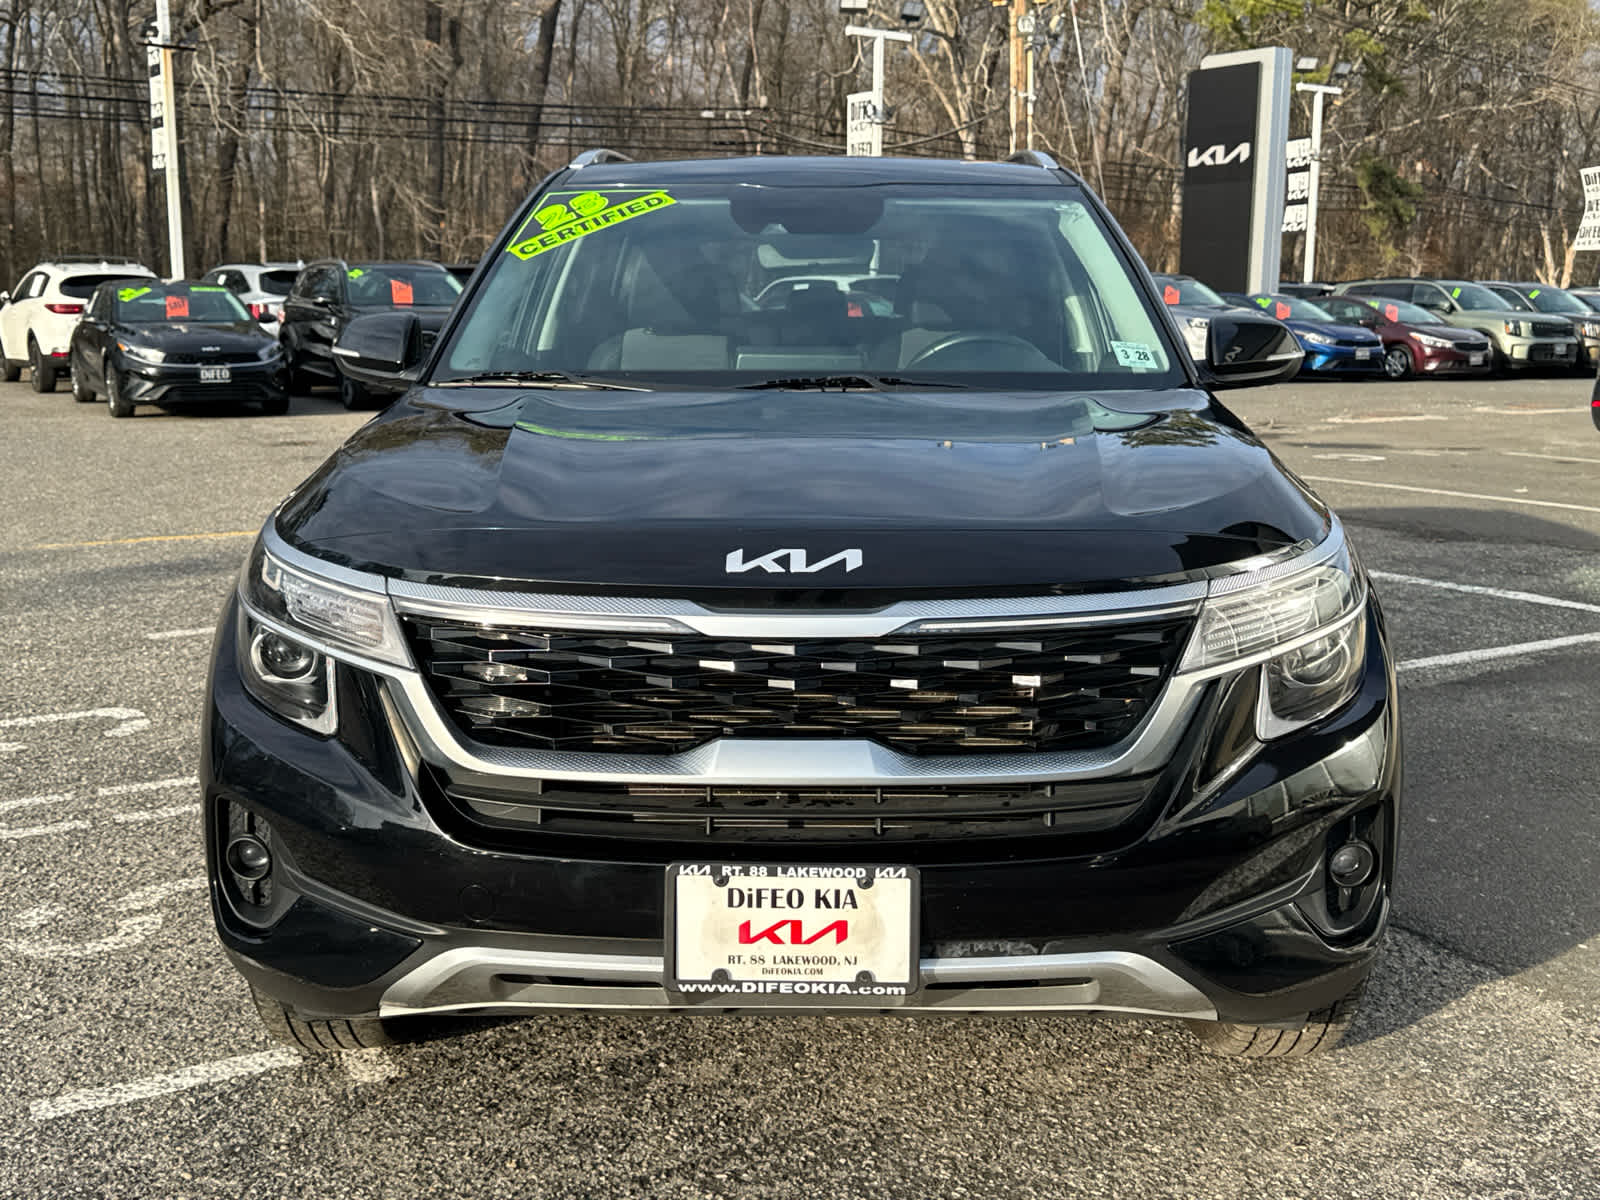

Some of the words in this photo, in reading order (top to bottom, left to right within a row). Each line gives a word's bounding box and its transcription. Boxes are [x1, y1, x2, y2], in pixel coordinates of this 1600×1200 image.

[1187, 142, 1250, 168] KIA
[519, 196, 664, 255] CERTIFIED
[1121, 349, 1130, 360] 3
[1135, 350, 1150, 361] 28
[725, 548, 863, 574] KIA
[679, 864, 711, 876] KIA
[721, 866, 745, 877] RT.
[749, 866, 768, 877] 88
[777, 866, 867, 878] LAKEWOOD
[875, 867, 907, 878] KIA
[727, 887, 805, 909] DiFEO
[814, 888, 858, 909] KIA
[738, 919, 848, 945] KIA
[727, 955, 746, 965] RT.
[750, 955, 766, 965] 88
[773, 955, 841, 967] LAKEWOOD,
[844, 956, 858, 966] NJ
[678, 982, 906, 995] www.DIFEOKIA.com
